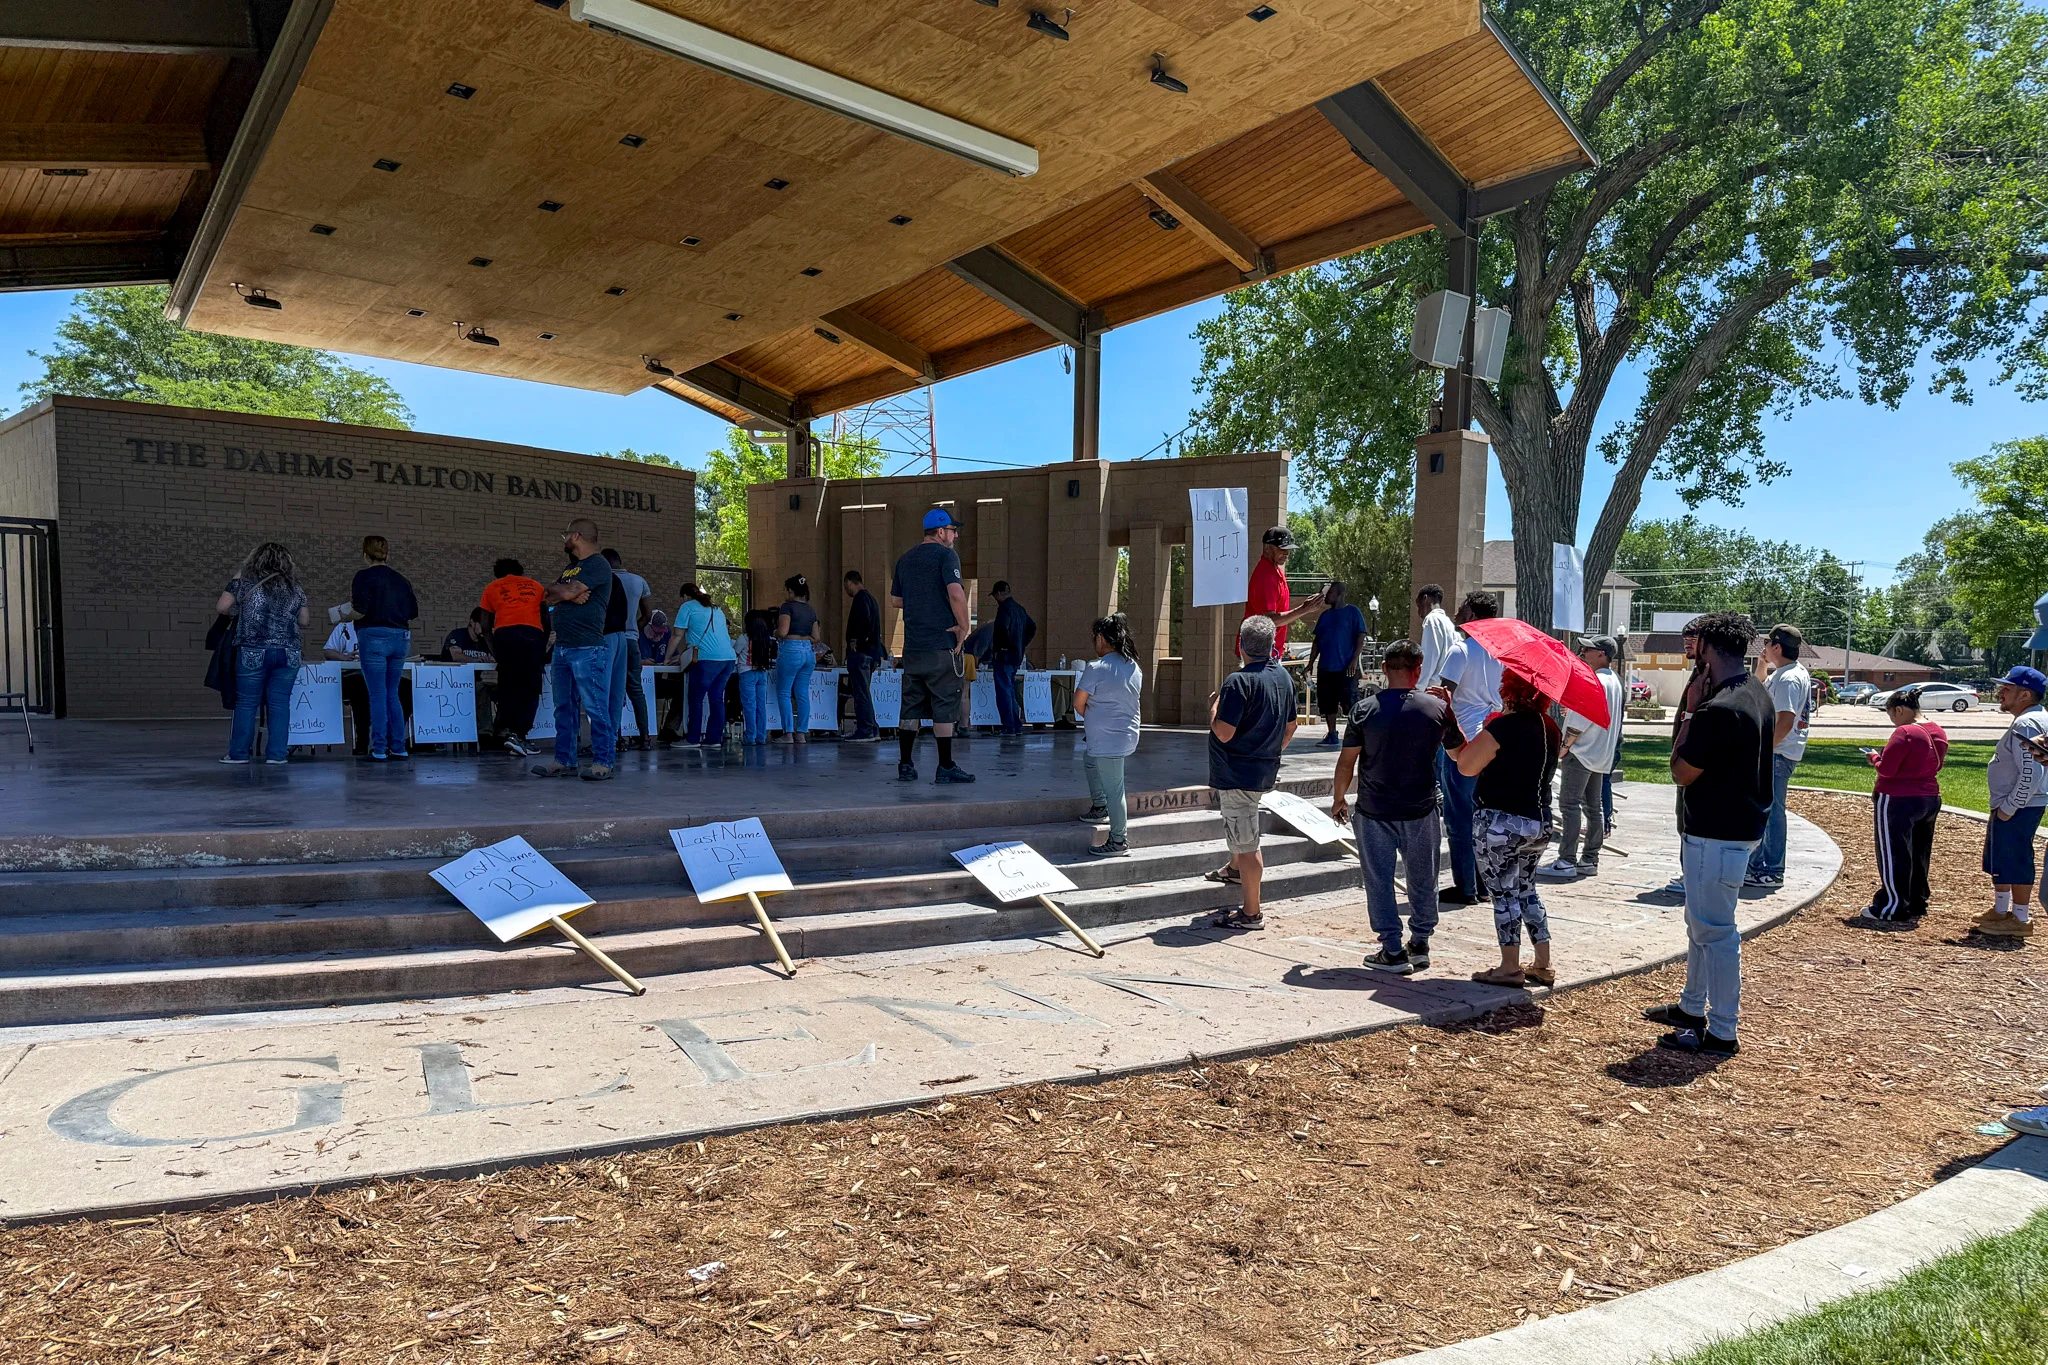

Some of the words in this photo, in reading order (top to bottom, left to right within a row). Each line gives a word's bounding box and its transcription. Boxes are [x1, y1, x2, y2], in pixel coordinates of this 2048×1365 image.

[126, 438, 208, 468] THE
[223, 446, 494, 493] DAHMS-TALTON
[506, 474, 582, 503] BAND
[591, 486, 662, 513] SHELL
[1195, 493, 1223, 522] Last
[305, 664, 339, 685] Name
[415, 666, 441, 689] Last
[441, 670, 474, 689] Name
[821, 673, 838, 686] Name
[289, 718, 326, 730] pellido
[417, 724, 461, 736] Apellido
[1136, 791, 1200, 811] HOMER
[677, 829, 718, 848] Last
[720, 822, 762, 841] Name
[955, 847, 997, 865] Last
[437, 860, 488, 889] Last
[478, 846, 537, 868] Name
[998, 880, 1051, 901] Apellido
